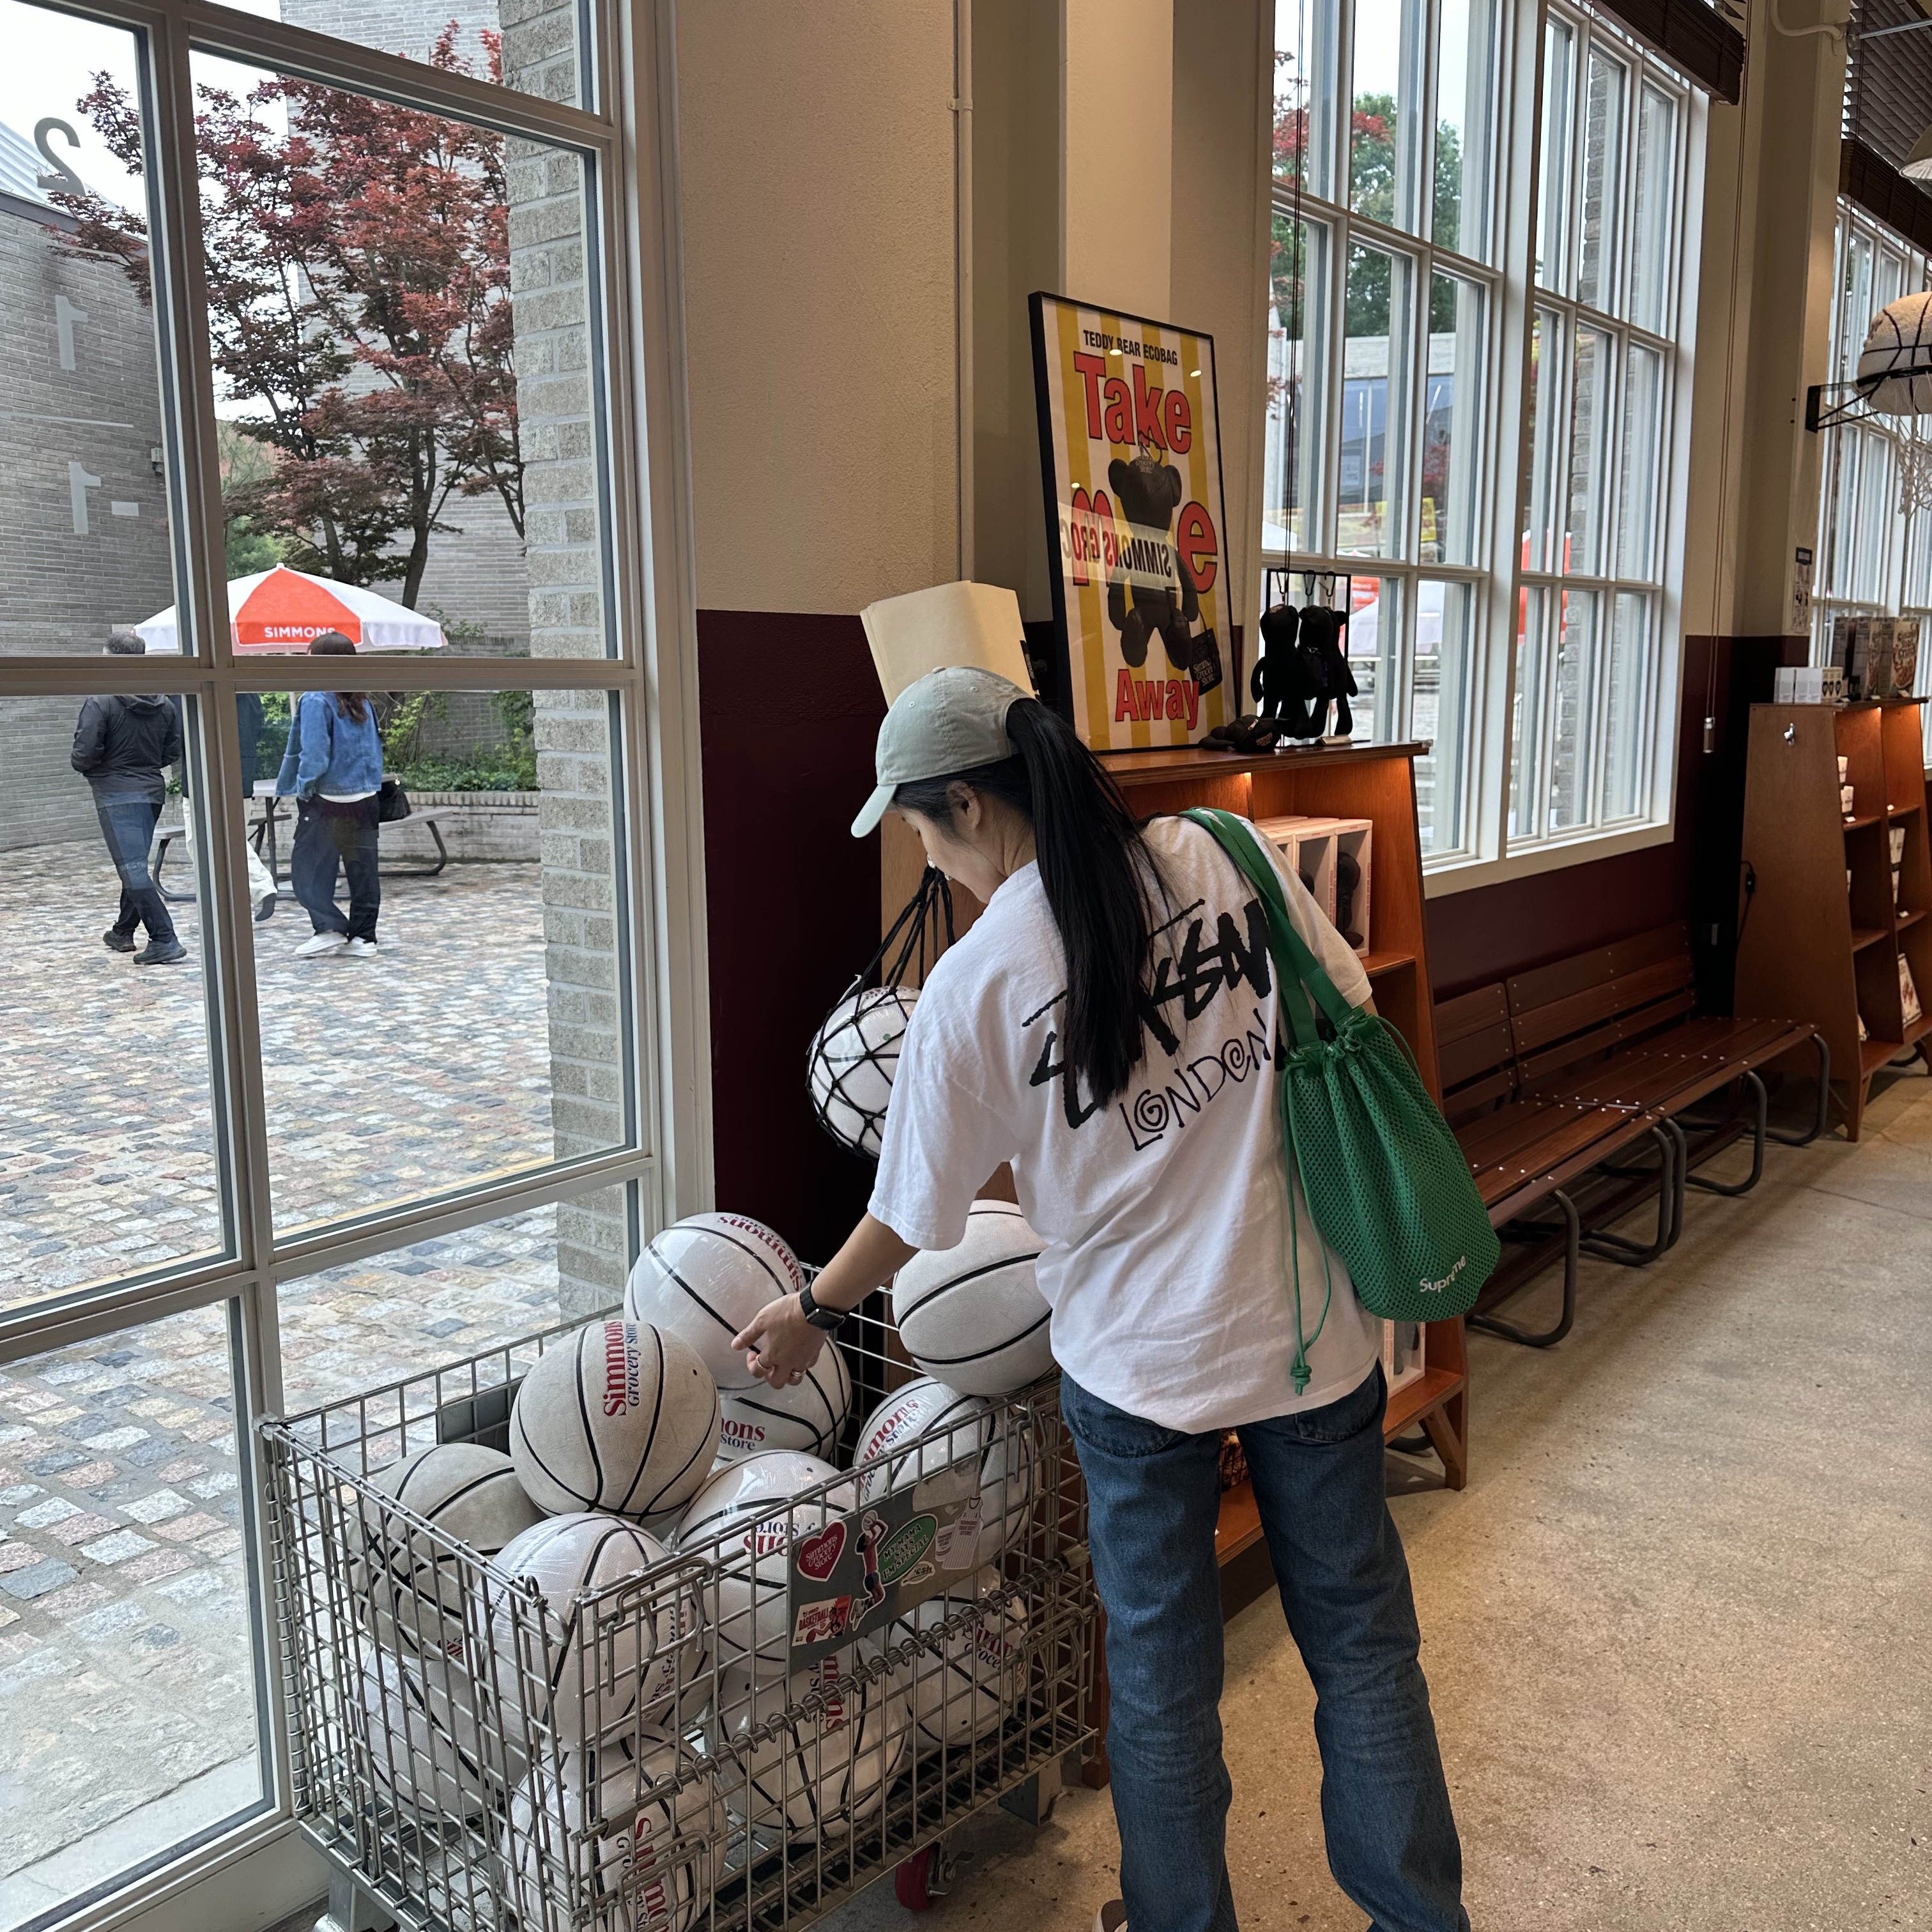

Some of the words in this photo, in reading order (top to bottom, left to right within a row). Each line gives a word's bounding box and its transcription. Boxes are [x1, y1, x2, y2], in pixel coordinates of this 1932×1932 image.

[1083, 329, 1114, 351] TEDDY
[1117, 337, 1141, 358] BEAR
[1143, 343, 1178, 366] ECOBAG
[1073, 350, 1192, 454] Take
[1115, 668, 1200, 730] Away
[1119, 1008, 1272, 1151] LONDON
[602, 1321, 627, 1416] Simmons
[627, 1347, 641, 1407] Grocery
[720, 1434, 756, 1451] Store
[805, 1533, 838, 1562] Simmons
[808, 1541, 838, 1567] Grocery
[814, 1552, 833, 1570] Store
[896, 1534, 929, 1569] SPECIAL
